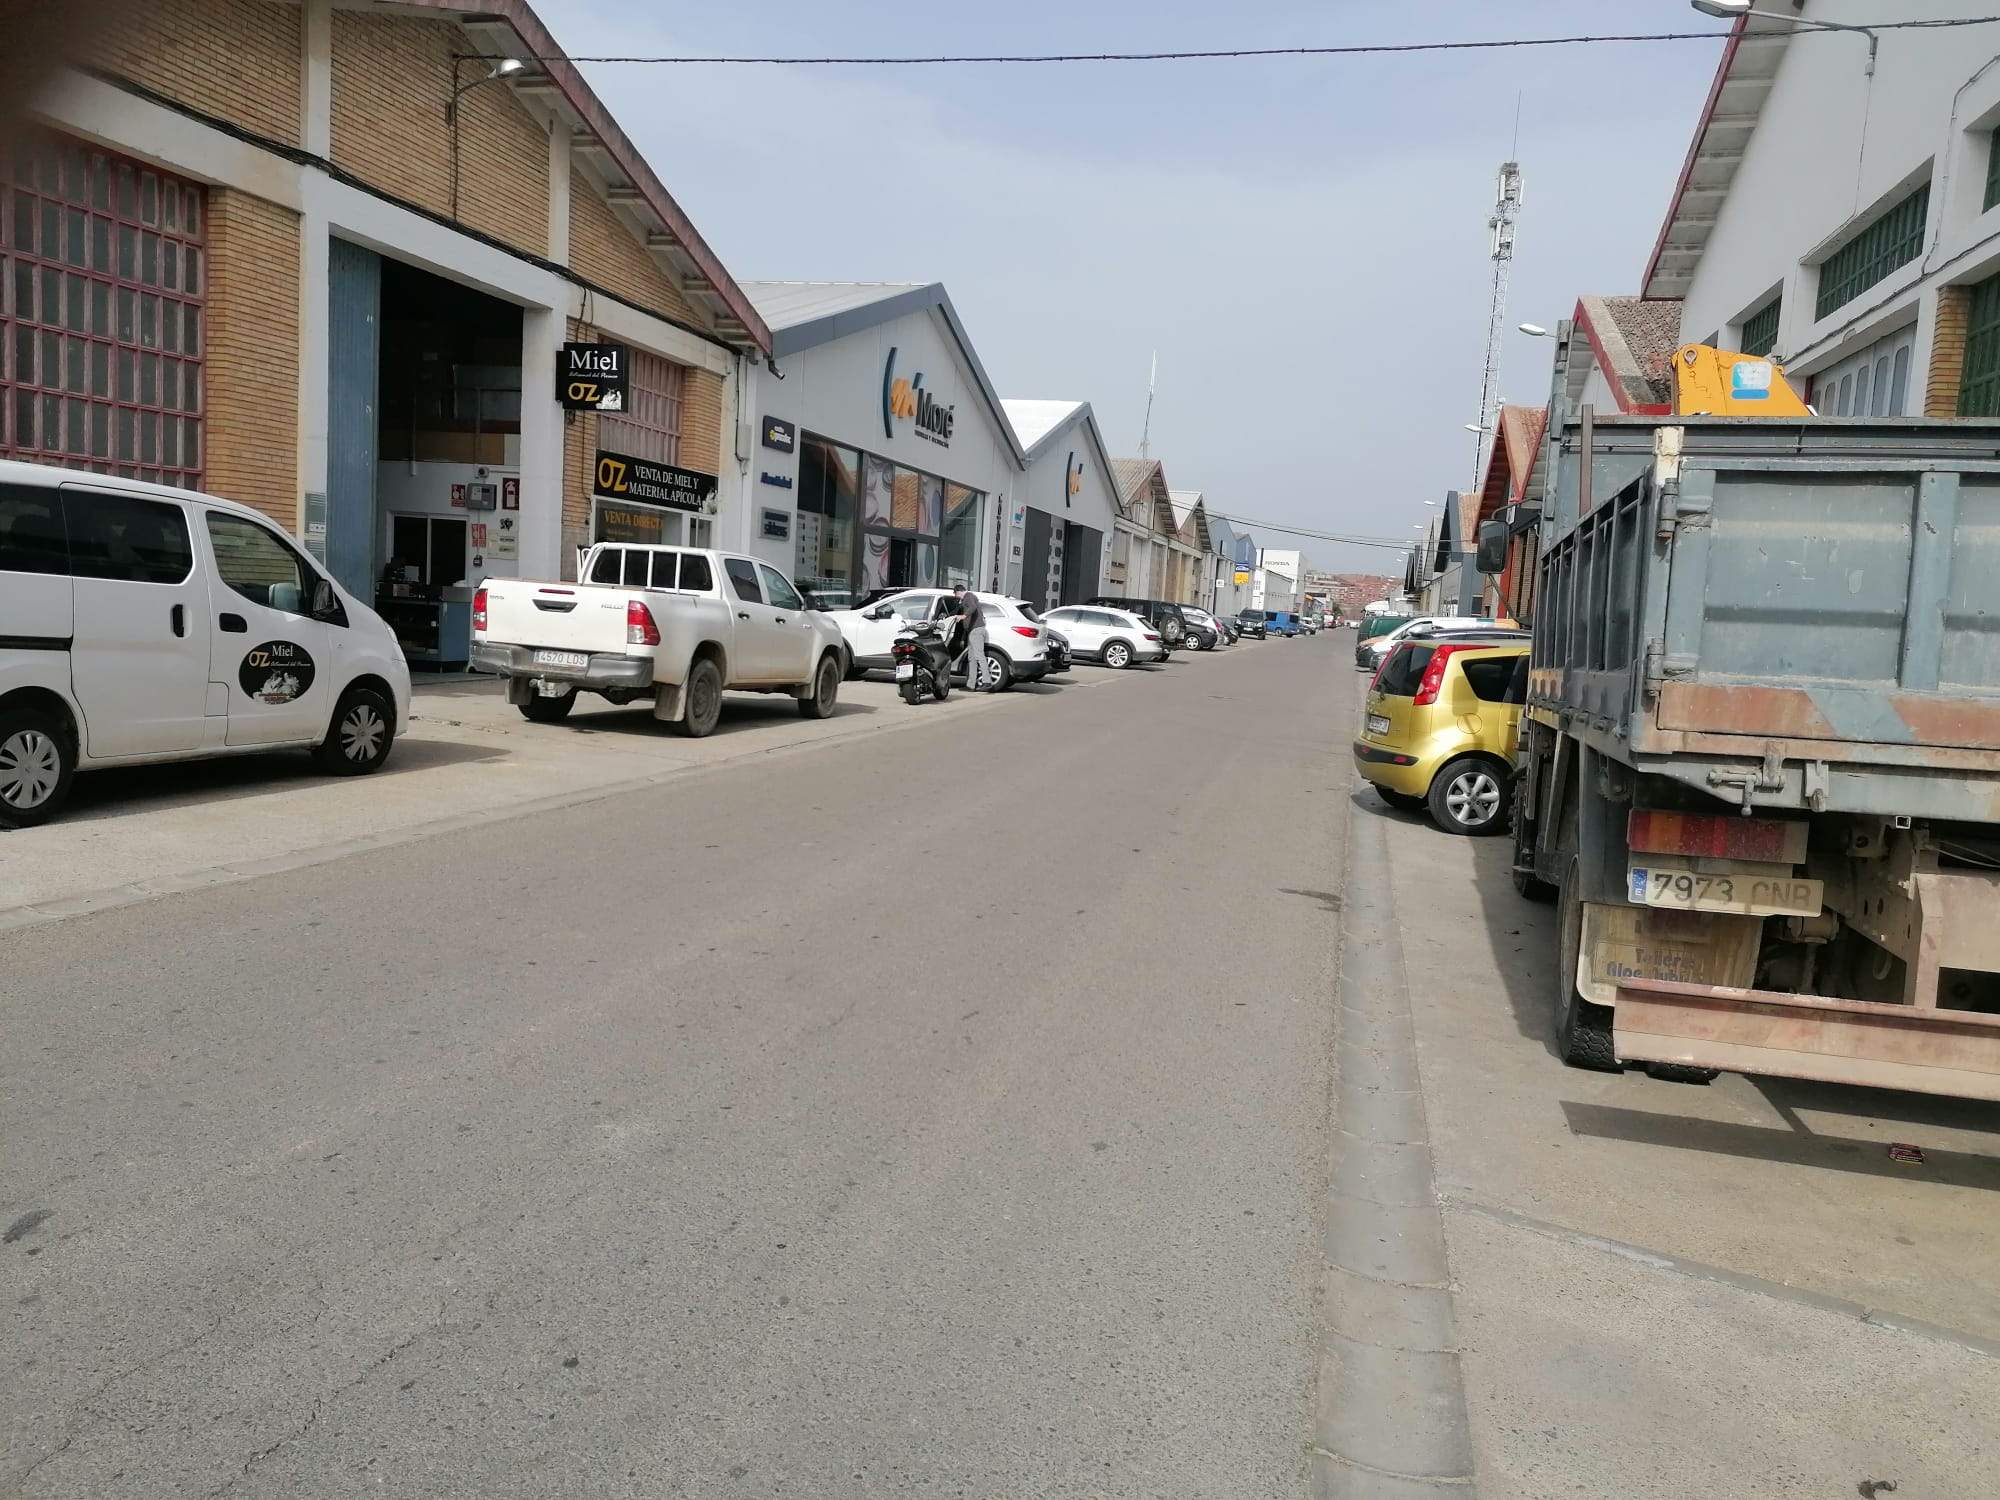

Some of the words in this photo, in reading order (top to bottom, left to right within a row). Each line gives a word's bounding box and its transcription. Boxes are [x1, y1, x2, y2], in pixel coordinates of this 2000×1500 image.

[569, 350, 619, 371] Miel
[568, 382, 601, 402] OZ
[598, 458, 628, 492] OZ
[635, 465, 661, 483] VENTA
[663, 471, 673, 485] DE
[674, 474, 692, 489] MIEL
[692, 479, 699, 490] Y
[628, 482, 670, 501] MATERIAL
[671, 488, 702, 506] APÍCOLA
[604, 510, 632, 526] VENTA
[248, 651, 271, 667] OZ
[272, 645, 293, 656] Miel
[1654, 873, 1734, 905] 7973
